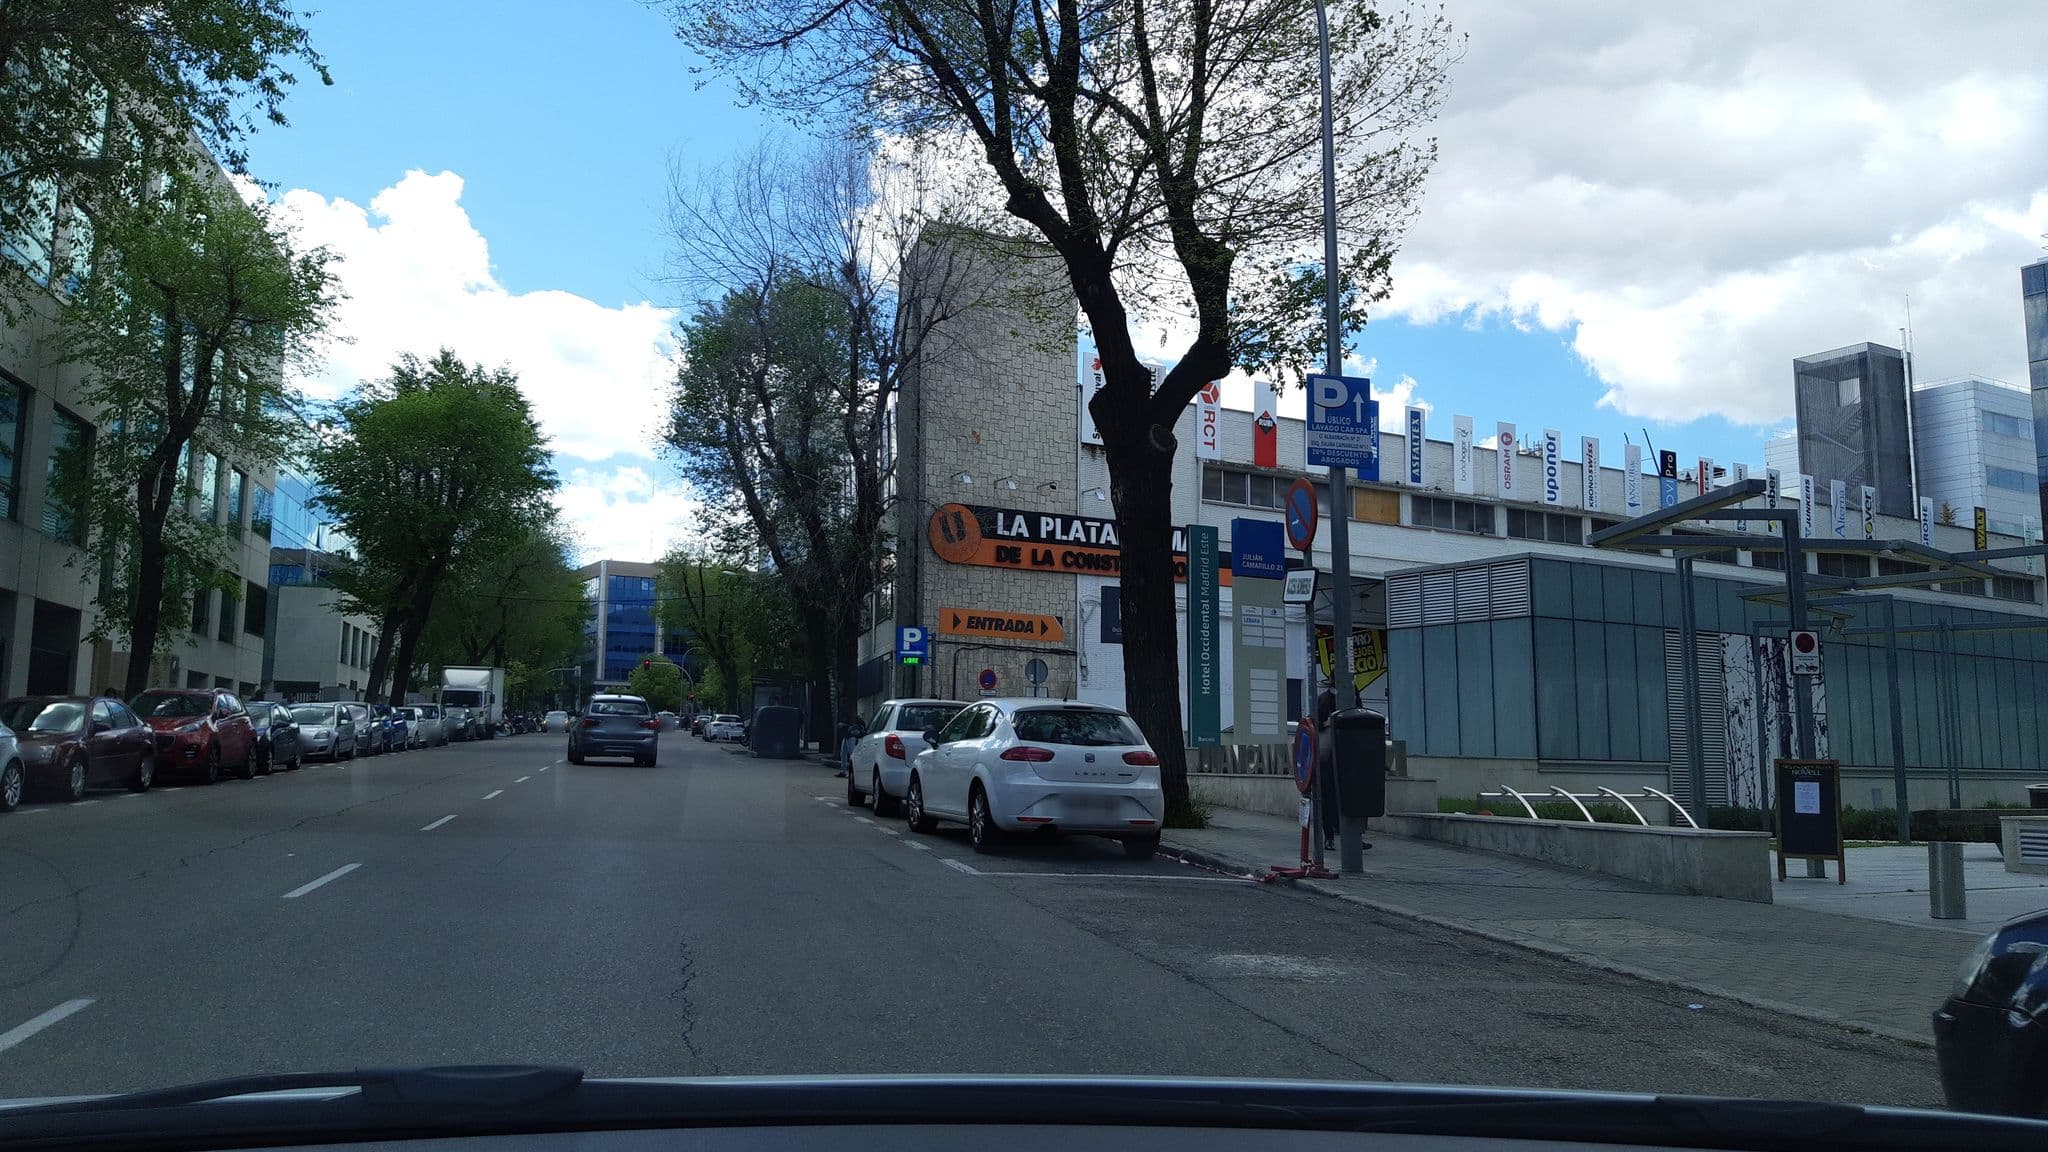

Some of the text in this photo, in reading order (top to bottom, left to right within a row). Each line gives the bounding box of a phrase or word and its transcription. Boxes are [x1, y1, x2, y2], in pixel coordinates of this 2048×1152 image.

[1203, 409, 1216, 451] RCT
[1411, 418, 1421, 477] ASFALTEX
[1546, 432, 1559, 502] uponor
[1767, 473, 1777, 508] eber
[997, 512, 1029, 538] LA
[996, 545, 1022, 564] DE
[1031, 548, 1055, 567] LA
[1242, 562, 1274, 570] CAMARILLO
[966, 615, 1034, 634] ENTRADA
[1200, 529, 1210, 695] Hotel Occidental Madrid Este
[903, 628, 922, 650] P
